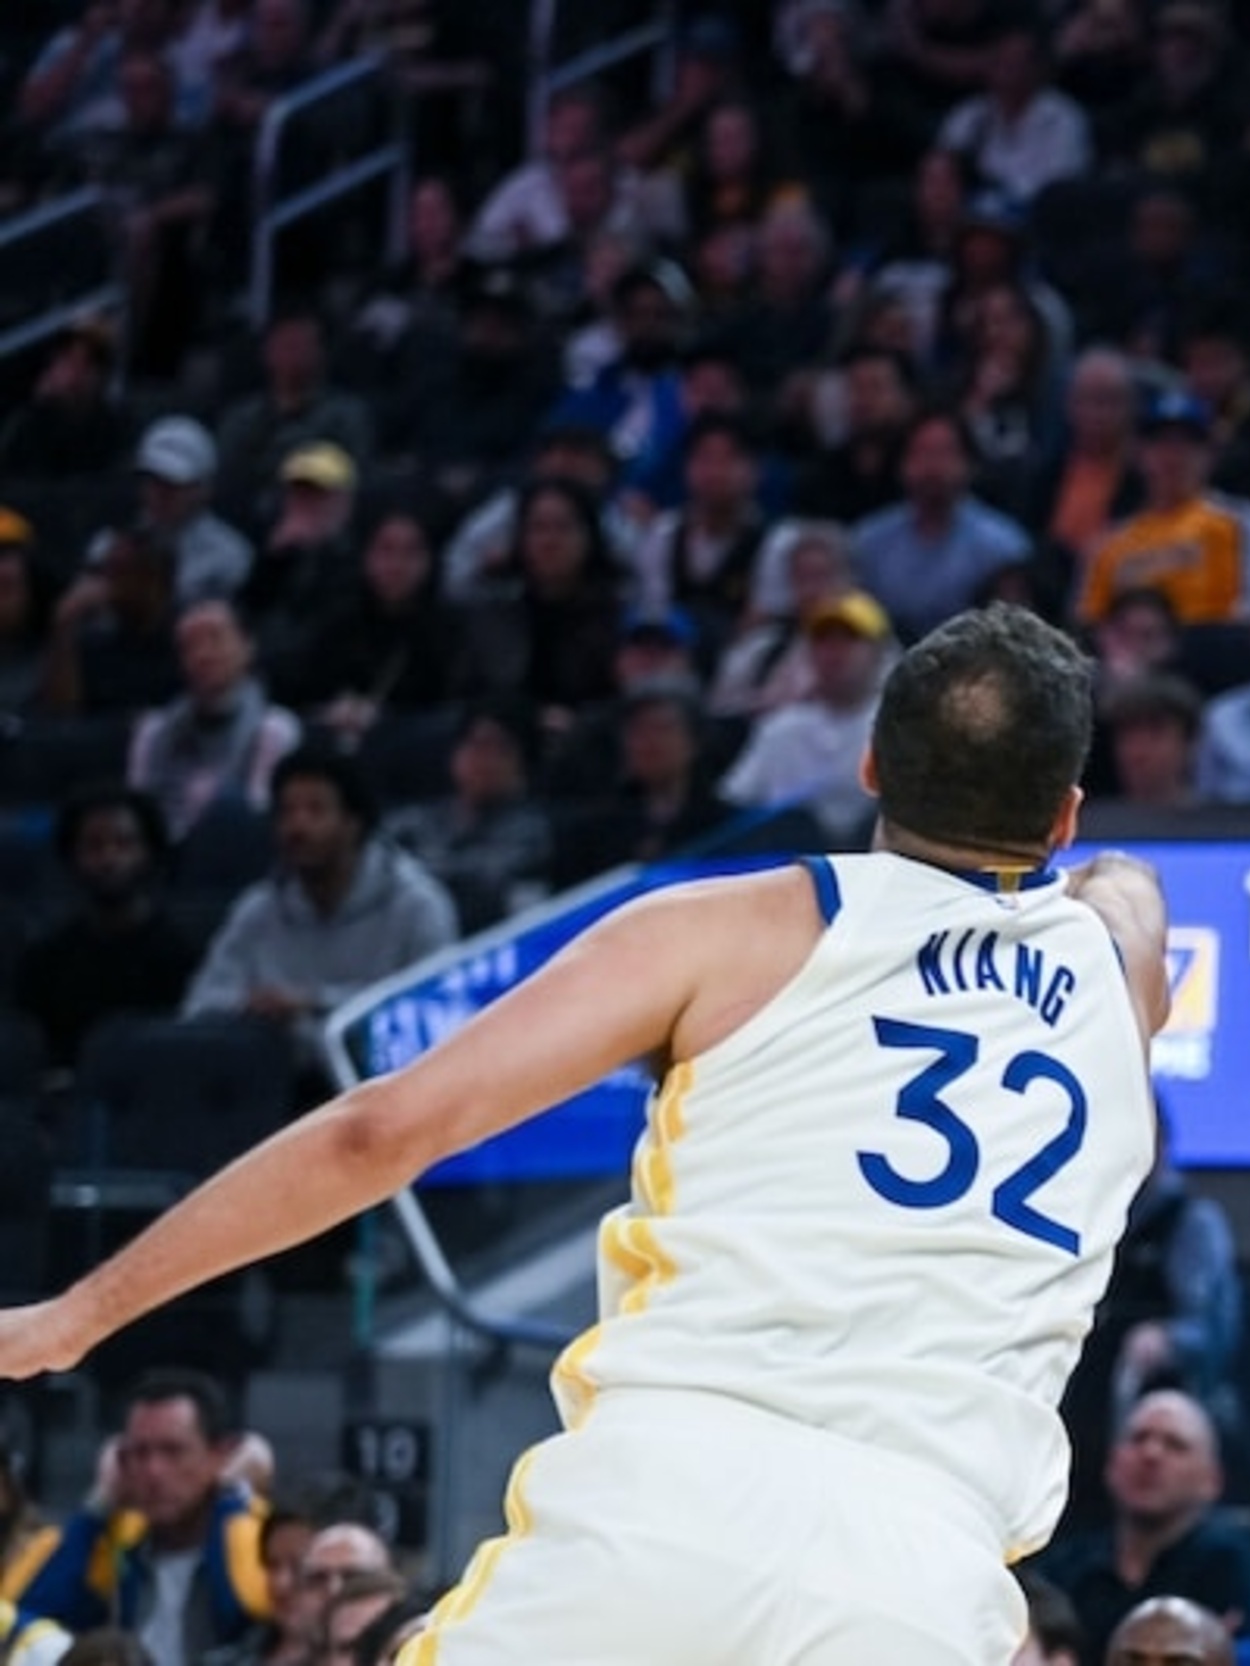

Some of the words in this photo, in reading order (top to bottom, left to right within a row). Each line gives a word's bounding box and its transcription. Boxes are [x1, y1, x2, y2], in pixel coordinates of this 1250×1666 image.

[916, 927, 1076, 1028] NIANG
[855, 1014, 1089, 1258] 32
[358, 1424, 418, 1481] 10
